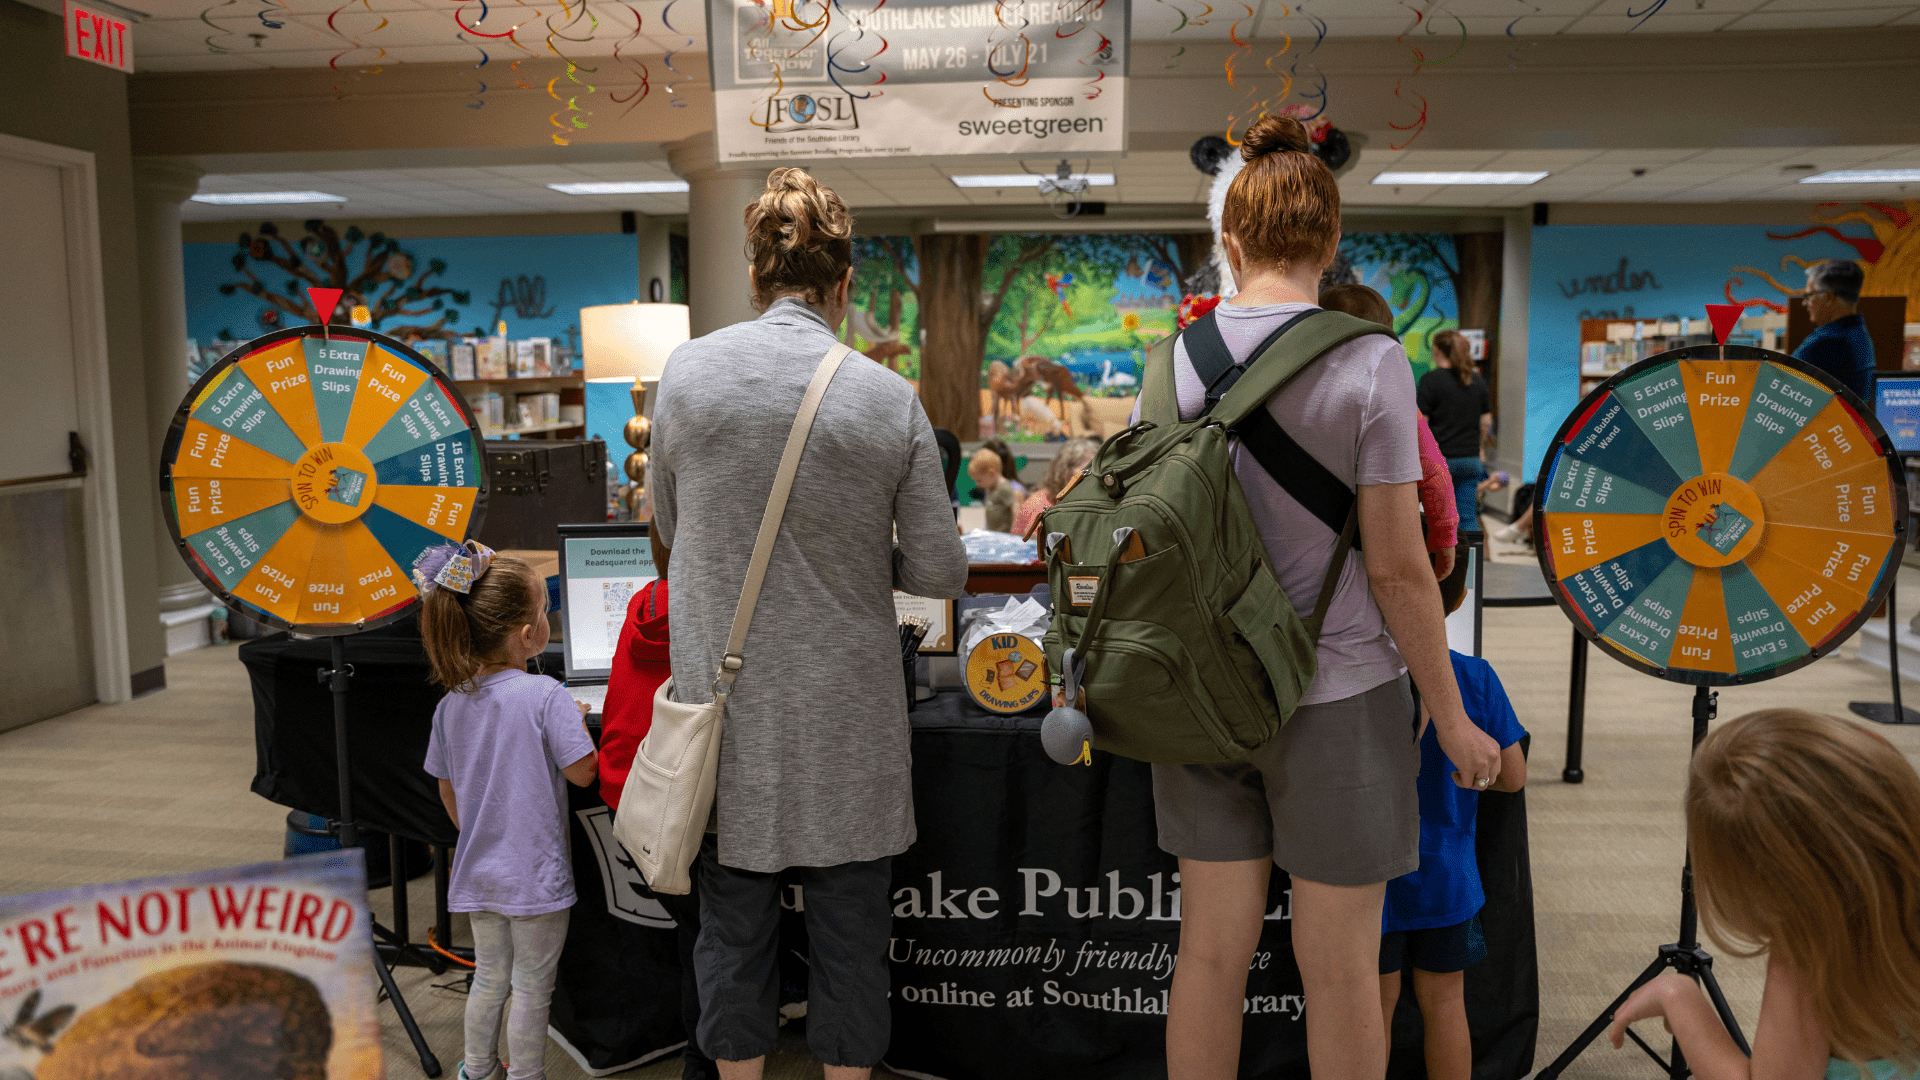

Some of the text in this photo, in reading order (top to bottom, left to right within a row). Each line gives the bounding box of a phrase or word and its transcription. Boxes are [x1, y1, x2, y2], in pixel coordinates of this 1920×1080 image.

[847, 1, 1104, 32] SOUTHLAKE SUMMER READING
[74, 8, 126, 68] EXIT
[903, 47, 941, 71] MAY
[946, 46, 968, 69] 26
[982, 42, 1023, 68] JULY
[1028, 42, 1048, 64] 21
[993, 96, 1075, 108] PRESENTING SPONSOR
[765, 134, 860, 145] Friends of the Southlake Library
[959, 116, 1104, 138] sweetgreen
[488, 274, 556, 335] All
[266, 355, 294, 373] Fun
[319, 350, 359, 361] 5 Extra
[270, 373, 307, 393] Prize
[315, 365, 362, 378] Drawing
[381, 363, 406, 383] Fun
[1706, 372, 1736, 385] Fun
[211, 381, 245, 414] 5 Extra
[322, 382, 350, 393] Slips
[367, 378, 401, 402] Prize
[1634, 377, 1678, 401] 5 Extra
[1700, 393, 1740, 407] Prize
[1769, 379, 1813, 408] 5 Extra
[222, 388, 263, 428] Drawing
[424, 393, 451, 428] 5 Extra
[1637, 391, 1688, 419] Drawing
[1756, 392, 1808, 427] Drawing
[242, 408, 266, 432] Slips
[401, 415, 421, 439] Slips
[408, 399, 441, 440] Drawing
[1577, 404, 1622, 454] Ninja Bubble
[1652, 412, 1684, 432] Slips
[1754, 412, 1786, 435] Slips
[190, 432, 208, 459] Fun
[211, 434, 230, 468] Prize
[1597, 425, 1621, 451] Wand
[1803, 433, 1833, 470] Prize
[1828, 425, 1852, 454] Fun
[420, 455, 431, 482] Slips
[452, 442, 464, 486] 15 Extra
[297, 446, 334, 510] SPIN TO WIN
[1560, 459, 1581, 500] 5 Extra
[1576, 466, 1597, 508] Drawin
[1595, 475, 1613, 504] Slips
[188, 486, 201, 513] Fun
[210, 480, 223, 515] Prize
[427, 494, 445, 527] Prize
[1669, 479, 1721, 538] SPIN TO WIN
[1836, 483, 1850, 522] Prize
[1862, 486, 1876, 514] Fun
[447, 502, 463, 527] Fun
[216, 527, 251, 568] Drawing
[238, 527, 259, 553] Slips
[1563, 527, 1576, 555] Fun
[1582, 519, 1597, 555] Prize
[206, 540, 235, 575] 5 Extra
[585, 559, 654, 567] Readsquared app
[590, 548, 646, 556] Download the
[1822, 541, 1850, 579] Prize
[261, 564, 295, 589] Prize
[358, 566, 393, 586] Prize
[1611, 562, 1633, 591] Slips
[1847, 554, 1871, 582] Fun
[255, 583, 281, 603] Fun
[309, 583, 344, 595] Prize
[370, 584, 397, 601] Fun
[1574, 572, 1609, 620] 15 Extra
[1786, 582, 1823, 614] Prize
[313, 602, 339, 614] Fun
[1643, 598, 1672, 619] Slips
[1737, 608, 1769, 625] Slips
[1807, 601, 1837, 627] Fun
[1622, 605, 1672, 639] Drawing
[1679, 625, 1718, 640] Prize
[1730, 622, 1785, 644] Drawing
[991, 635, 1018, 650] KID
[1618, 622, 1658, 651] 5 Extra
[1741, 638, 1788, 659] 5 Extra
[1682, 646, 1711, 660] Fun
[979, 688, 1040, 708] DRAWING SLIPS
[1018, 867, 1181, 922] Publi
[95, 886, 197, 946] NOT
[208, 885, 355, 944] WEIRD
[46, 962, 78, 982] and
[80, 949, 156, 971] Function
[182, 938, 205, 951] the
[213, 938, 267, 950] Animal
[271, 939, 338, 962] Kingdom
[889, 937, 1178, 981] Uncommonly friendly
[902, 982, 996, 1008] online
[1006, 981, 1034, 1008] at
